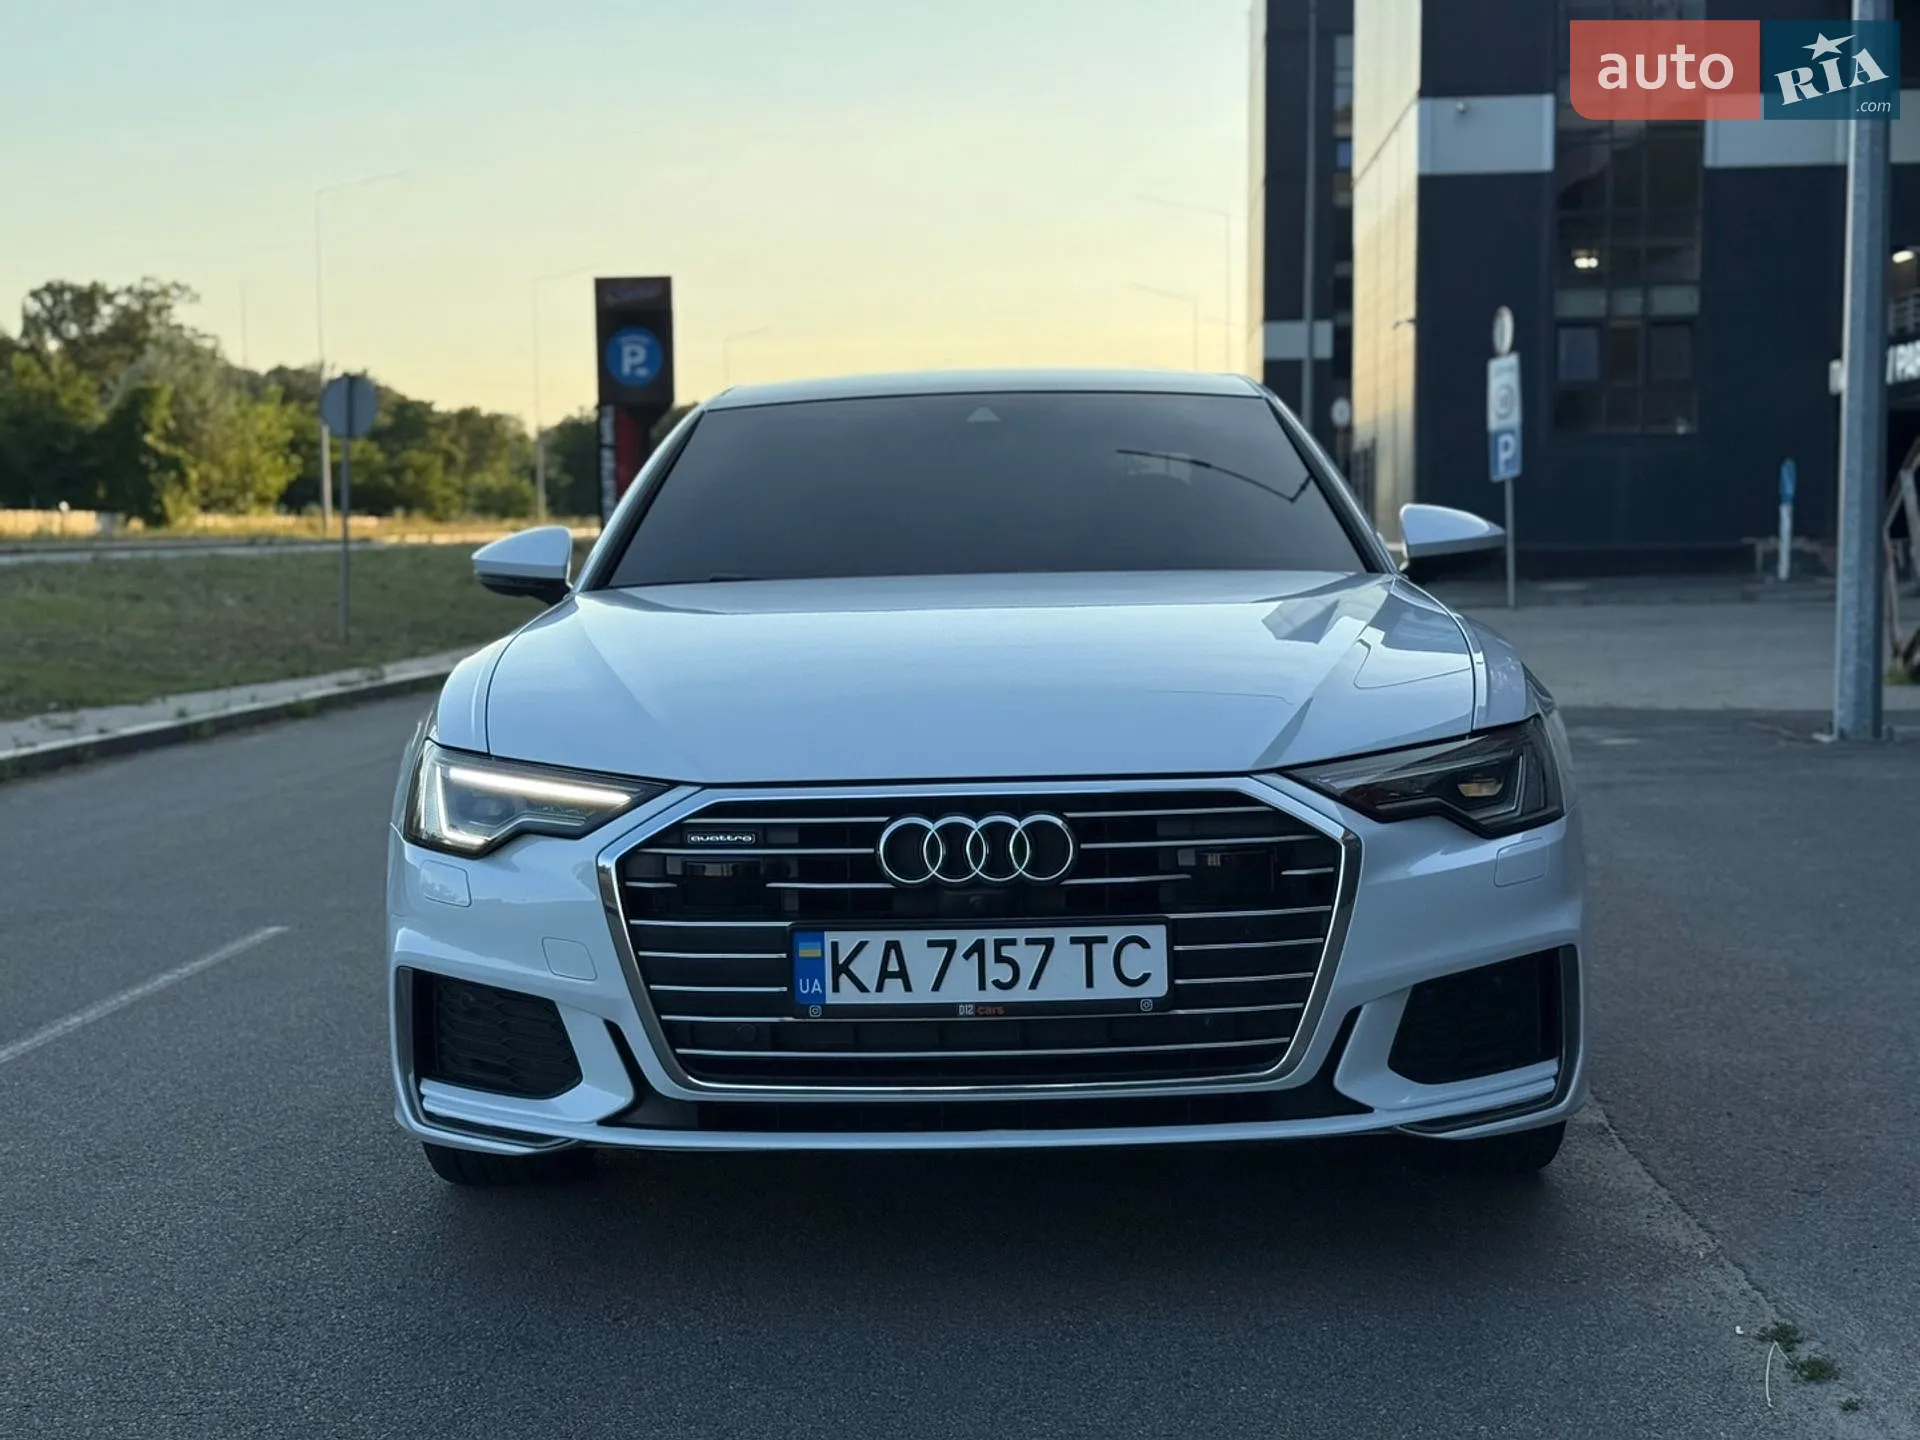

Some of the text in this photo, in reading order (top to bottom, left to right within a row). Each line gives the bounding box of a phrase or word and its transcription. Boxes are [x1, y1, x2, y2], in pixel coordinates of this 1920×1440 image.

[1497, 432, 1516, 475] P
[690, 834, 753, 843] quattro
[830, 934, 1152, 993] KA 7157 TC
[799, 978, 823, 994] UA
[977, 1005, 1005, 1016] cars
